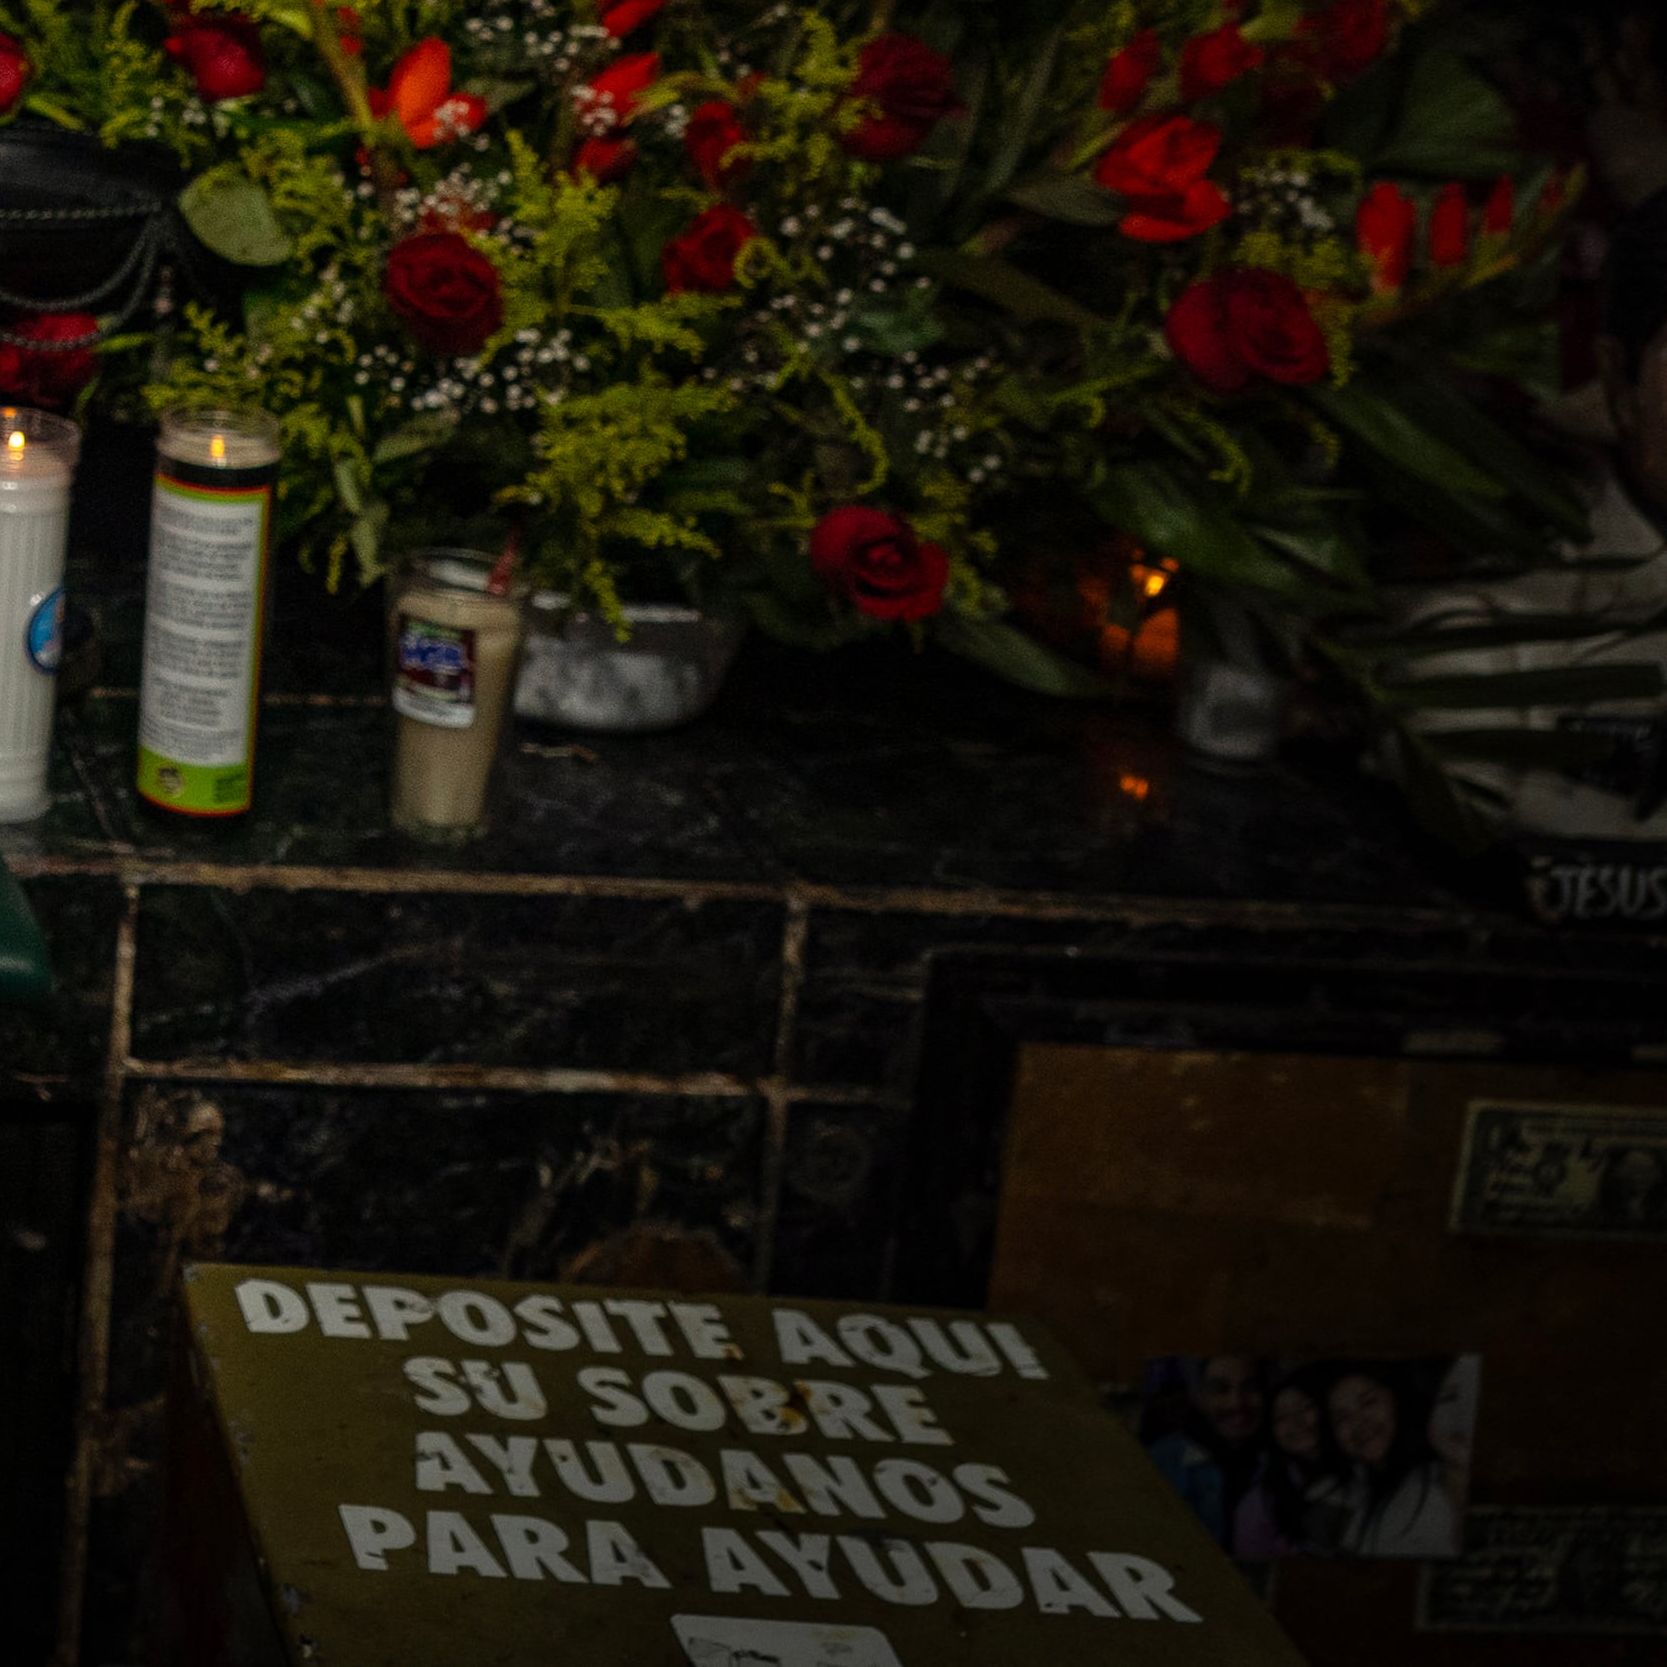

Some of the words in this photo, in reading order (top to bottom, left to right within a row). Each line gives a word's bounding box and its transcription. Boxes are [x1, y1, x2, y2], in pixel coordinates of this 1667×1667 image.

[234, 1277, 745, 1363] DEPOSITE
[766, 1306, 1051, 1382] AQUI
[401, 1354, 548, 1422] SU
[576, 1365, 956, 1447] SOBRE
[413, 1430, 1037, 1530] AYUDANOS
[337, 1503, 673, 1591] PARA
[697, 1524, 1206, 1626] AYUDAR
